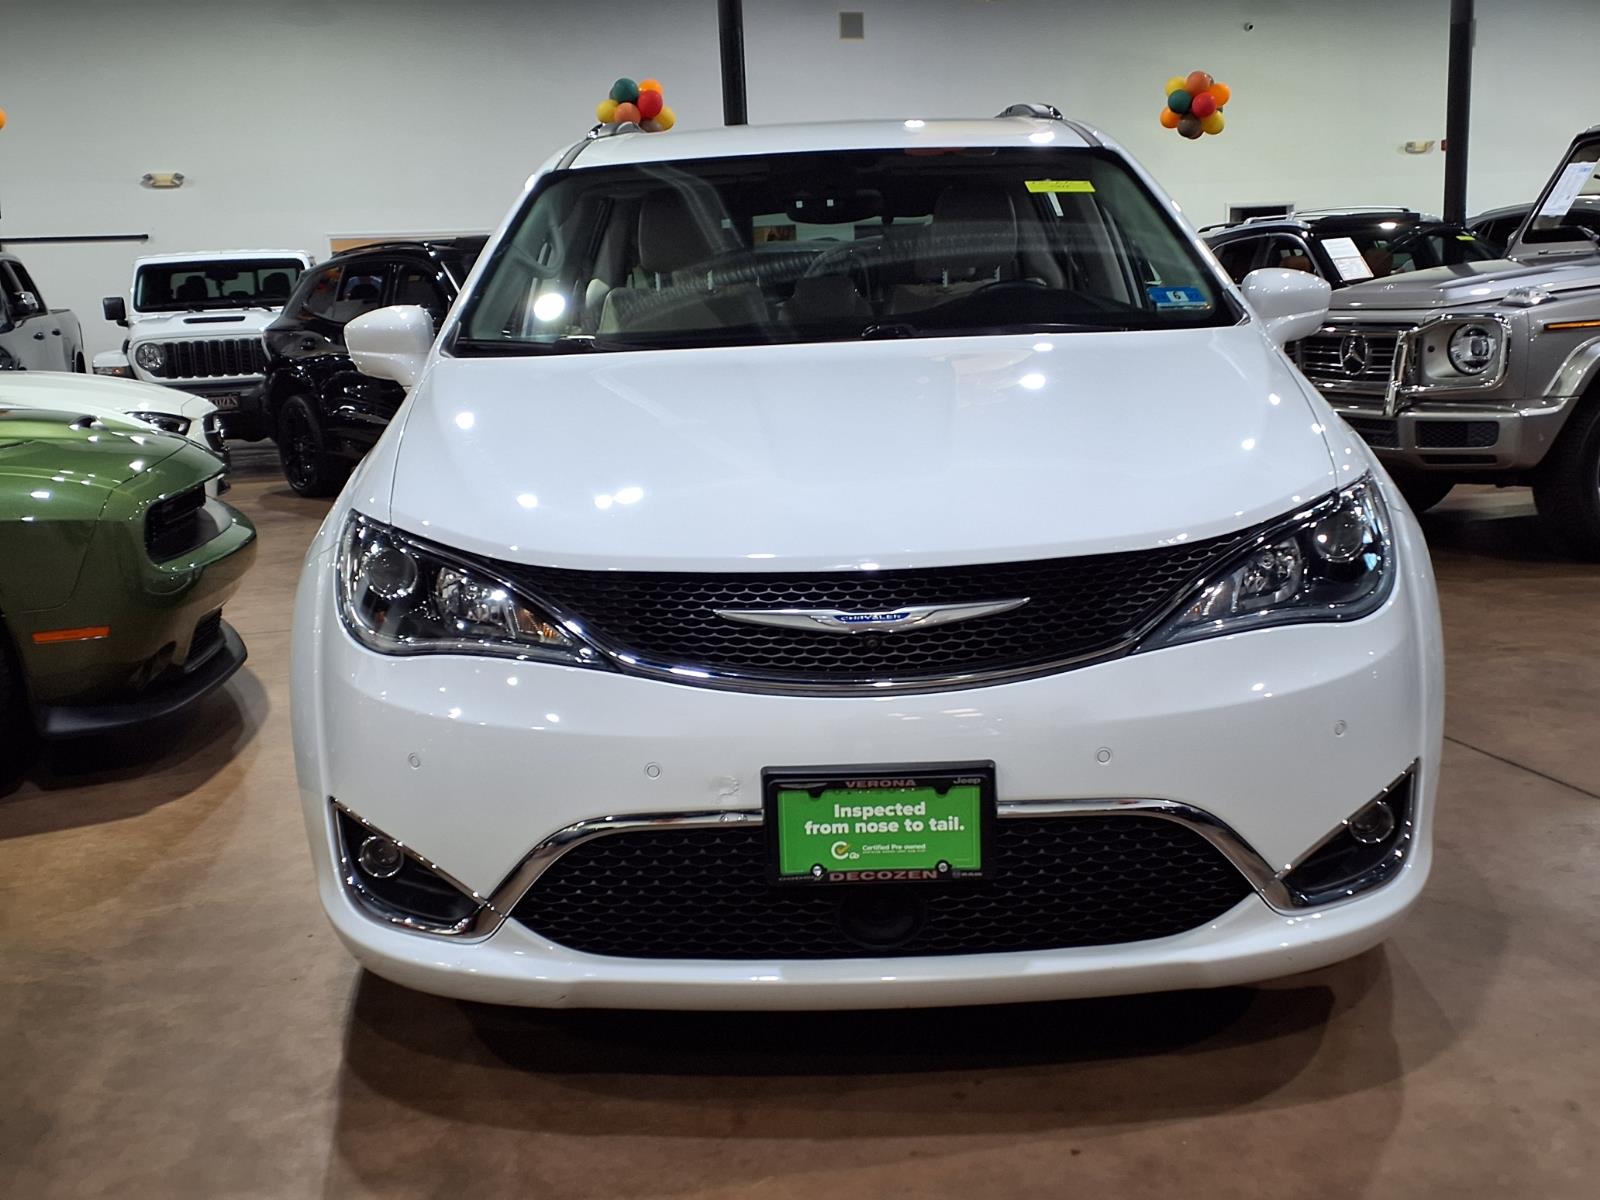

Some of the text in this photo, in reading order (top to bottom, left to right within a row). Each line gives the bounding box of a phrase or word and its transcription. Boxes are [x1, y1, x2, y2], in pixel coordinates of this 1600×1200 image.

[845, 779, 917, 788] VERONA
[953, 776, 981, 785] Jeep
[834, 801, 926, 820] Inspected
[804, 816, 965, 835] from nose to tail.
[829, 870, 938, 882] DECOZEN
